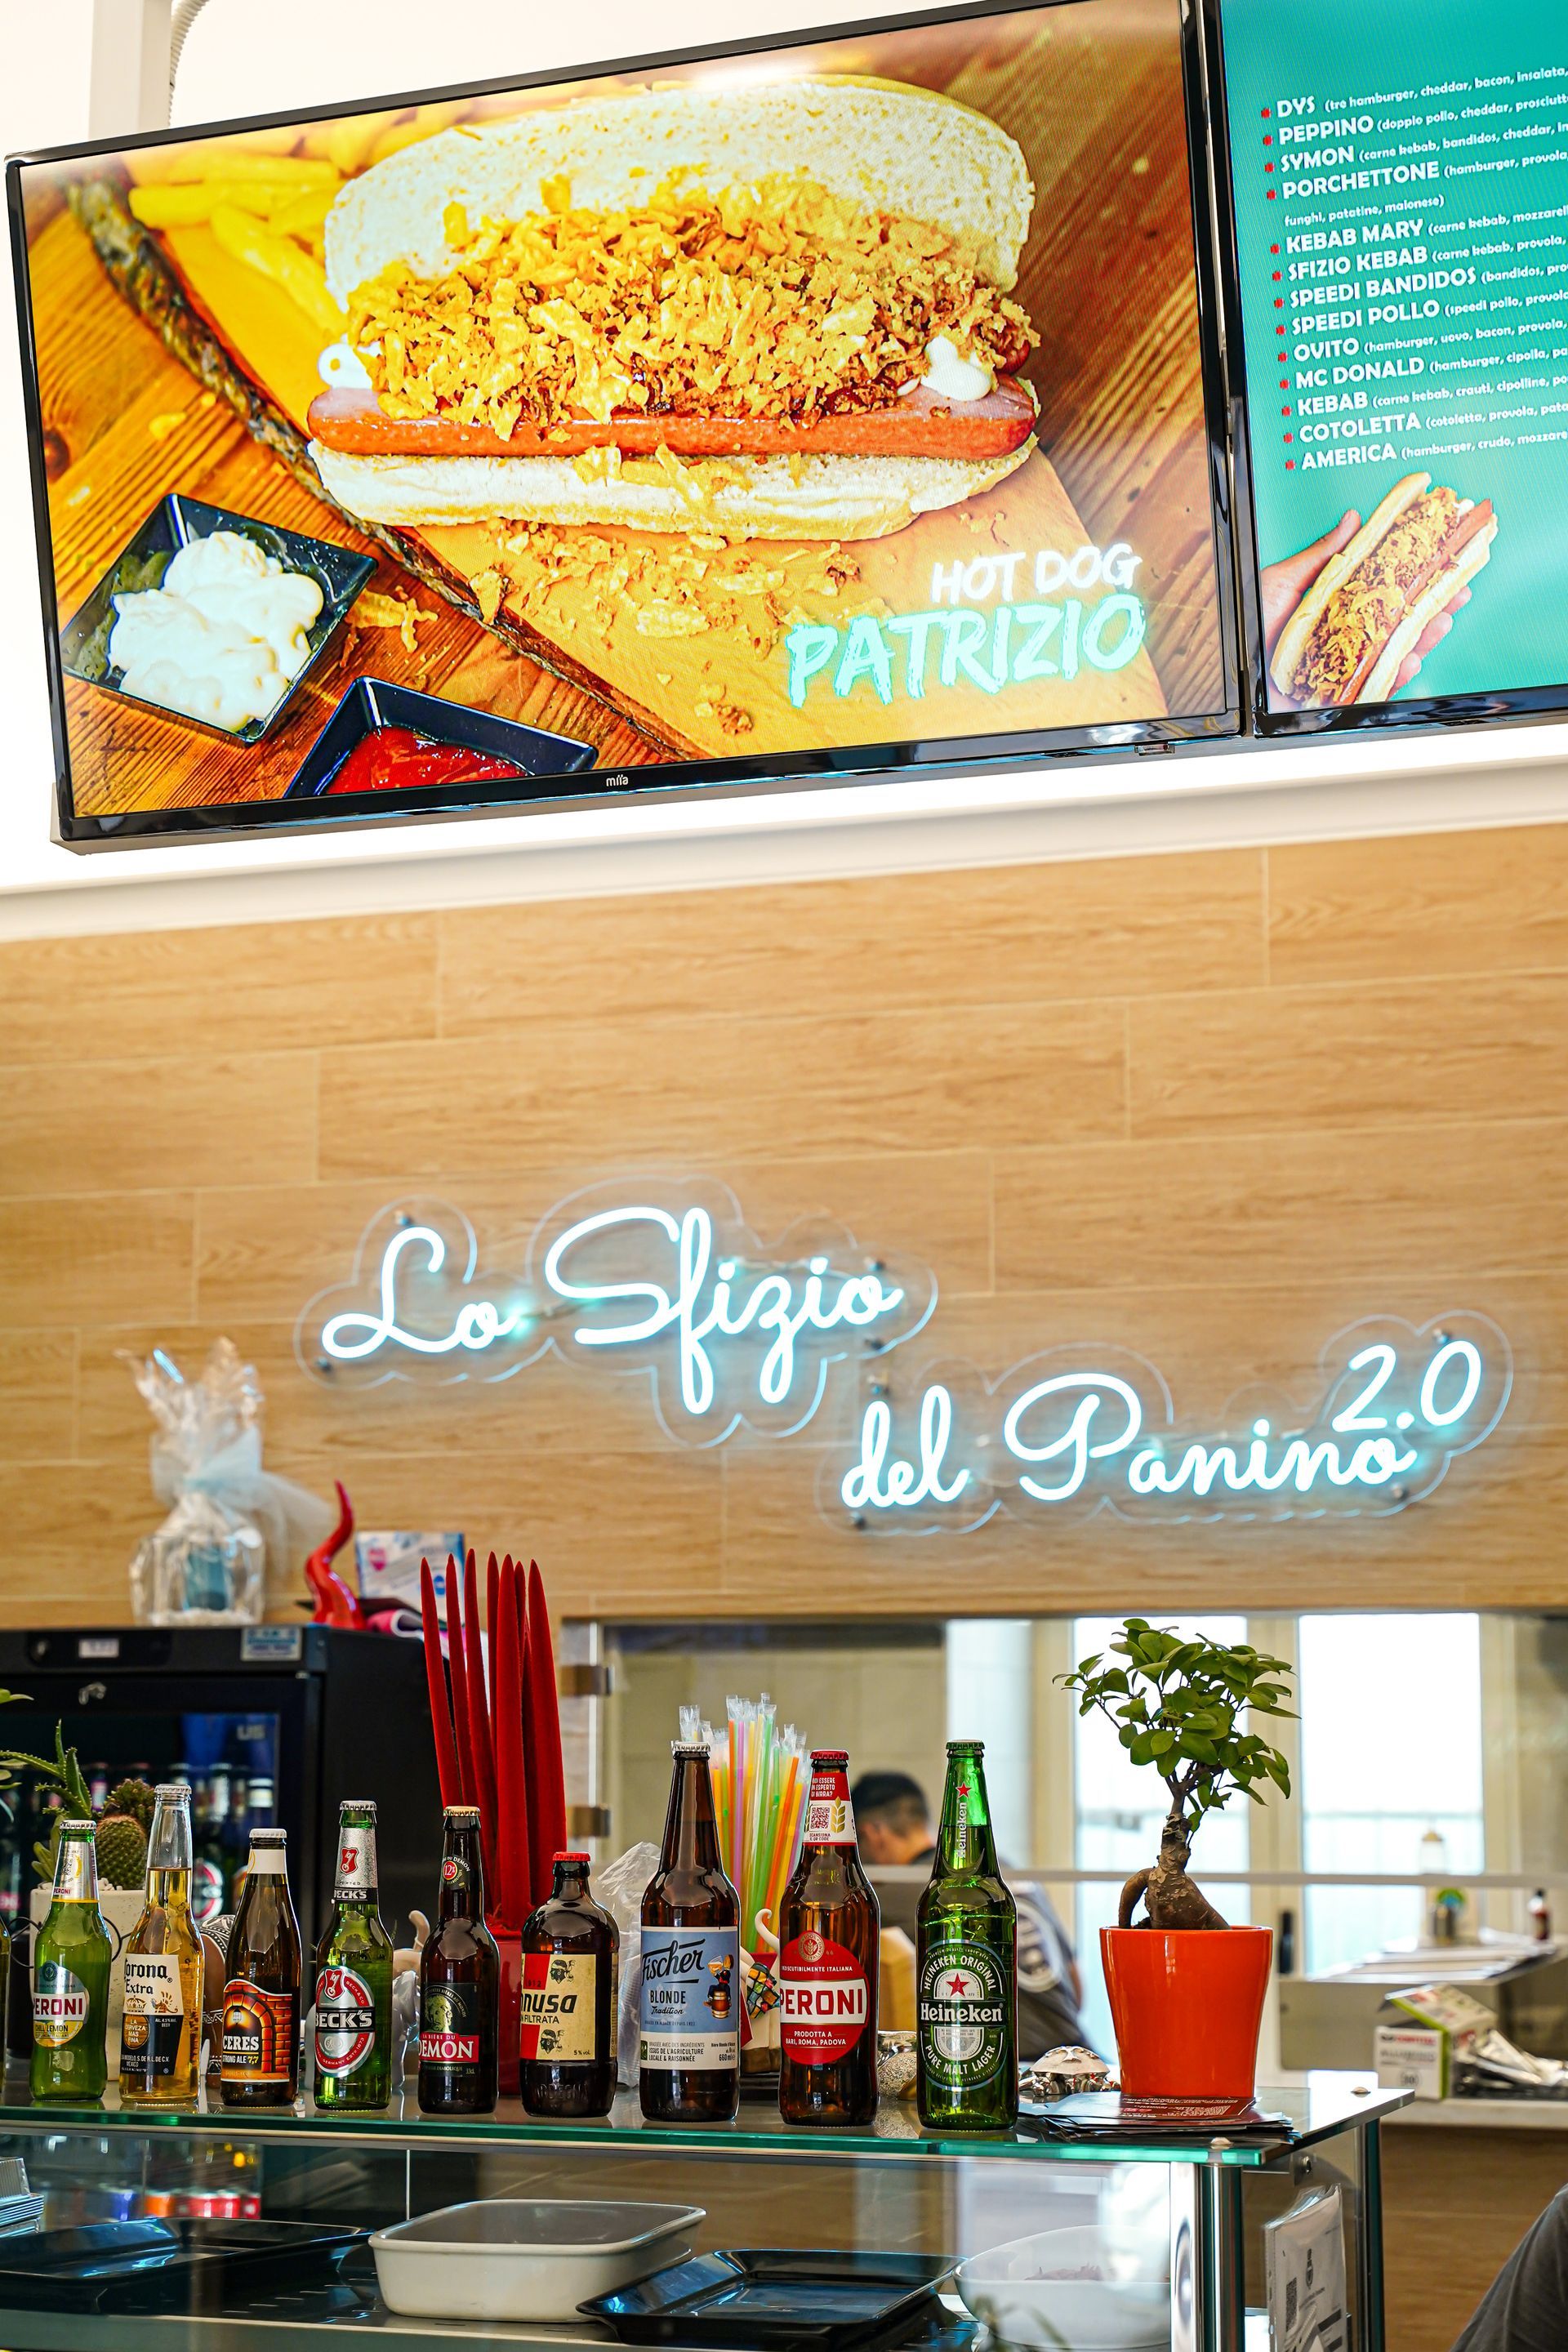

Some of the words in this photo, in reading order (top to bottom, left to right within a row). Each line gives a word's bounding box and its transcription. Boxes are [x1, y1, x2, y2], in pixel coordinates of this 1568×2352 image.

[1277, 96, 1315, 118] DYS
[1325, 99, 1347, 113] (tre
[1349, 91, 1418, 108] hamburger,
[1420, 81, 1472, 97] cheddar,
[1474, 75, 1514, 89] bacon,
[1279, 115, 1374, 145] PEPPINO
[1377, 115, 1423, 132] (doppio
[1426, 110, 1459, 126] pollo,
[1460, 102, 1513, 118] cheddar,
[1281, 145, 1354, 172] SYMON
[1359, 148, 1396, 163] (carne
[1398, 140, 1441, 155] kebab,
[1442, 132, 1500, 149] bandidos,
[1503, 123, 1555, 140] cheddar,
[1282, 160, 1440, 199] PORCHETTONE
[1443, 158, 1519, 179] (hamburger,
[1285, 212, 1326, 227] funghi,
[1328, 206, 1383, 223] patatine,
[1384, 194, 1445, 214] maionese)
[1285, 228, 1356, 254] KEBAB
[1362, 218, 1423, 243] MARY
[1428, 221, 1466, 237] (carne
[1468, 213, 1510, 229] kebab,
[1288, 256, 1351, 282] SFIZIO
[1356, 246, 1428, 272] KEBAB
[1432, 248, 1470, 264] (carne
[1472, 241, 1514, 256] kebab,
[1517, 234, 1566, 252] provola,
[1290, 282, 1361, 309] SPEEDI
[1366, 266, 1477, 298] BANDIDOS
[1481, 265, 1544, 284] (bandidos,
[1547, 263, 1568, 276] pro
[1292, 310, 1362, 336] SPEEDI
[1368, 299, 1440, 325] POLLO
[1444, 299, 1487, 318] (speedi
[1490, 296, 1523, 312] pollo,
[1294, 337, 1359, 362] OVITO
[1364, 336, 1438, 355] (hamburger,
[1441, 332, 1473, 344] uovo,
[1475, 327, 1515, 340] bacon,
[1517, 318, 1567, 336] provola,
[1295, 368, 1328, 390] MC
[1333, 357, 1424, 385] DONALD
[1429, 357, 1504, 374] (hamburger,
[1506, 348, 1550, 363] cipolla,
[1298, 391, 1368, 416] KEBAB
[1372, 394, 1410, 409] (carne
[1412, 388, 1453, 403] kebab,
[1455, 382, 1494, 397] crauti,
[1496, 376, 1549, 393] cipolline,
[1299, 412, 1421, 443] COTOLETTA
[1425, 412, 1486, 430] (cotoletta,
[1489, 406, 1538, 422] provola,
[1302, 443, 1397, 470] AMERICA
[1401, 443, 1476, 461] (hamburger,
[1477, 436, 1515, 451] crudo,
[1517, 430, 1568, 445] mozzare
[931, 552, 1026, 604] HOT
[1035, 543, 1143, 595] DOG
[786, 593, 1147, 708] PATRIZIO
[322, 1226, 518, 1360] Lo
[545, 1206, 905, 1414] Sfizio
[840, 1384, 972, 1508] del
[1003, 1372, 1418, 1502] Panino
[1331, 1339, 1482, 1432] 2.0
[957, 1802, 967, 1858] Heineken
[641, 1938, 706, 1986] Fischer
[924, 1954, 956, 1990] HEINEKEN
[960, 1955, 996, 1991] ORIGINAL
[126, 1979, 154, 1994] Extra
[521, 1993, 577, 2014] nusa
[650, 1990, 686, 2004] BLONDE
[780, 1988, 863, 2016] PERONI
[33, 1998, 83, 2016] ERONI
[523, 2015, 559, 2025] FILTRATA
[651, 2006, 684, 2016] Tradition
[920, 2002, 1003, 2022] Heineken
[222, 2035, 260, 2051] CERES
[236, 2056, 247, 2064] ALE
[247, 2056, 259, 2065] 7,7
[667, 2054, 696, 2062] RAISONNÉE
[925, 2044, 942, 2069] PURE
[943, 2062, 968, 2075] MALT
[971, 2044, 996, 2072] LAGER
